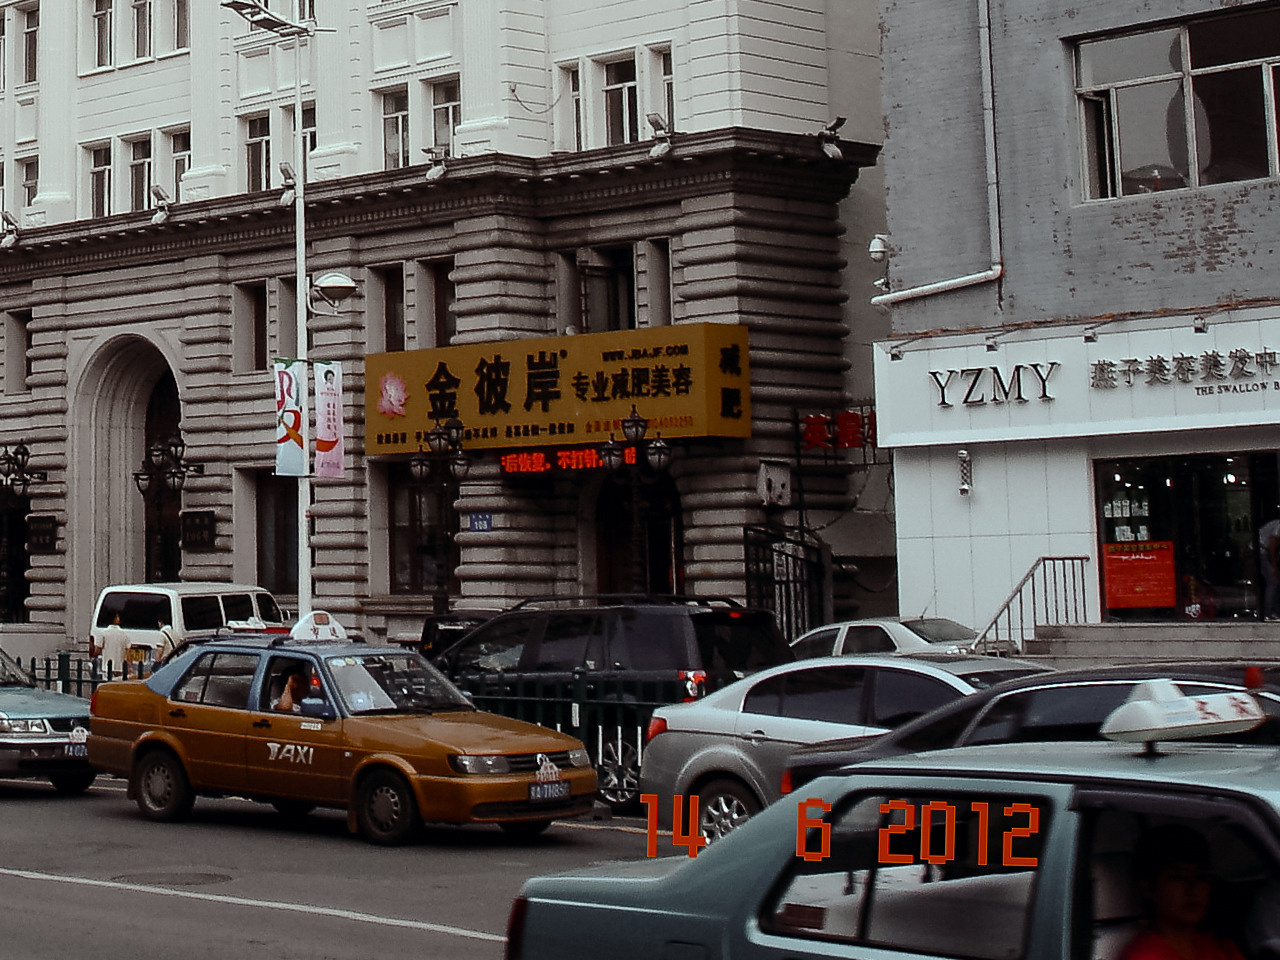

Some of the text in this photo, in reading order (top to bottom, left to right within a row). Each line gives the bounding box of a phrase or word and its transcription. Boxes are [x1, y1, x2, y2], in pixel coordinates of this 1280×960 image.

[425, 351, 561, 420] 金彼岸
[571, 364, 693, 403] 专业减肥美容
[928, 361, 1061, 407] YZMY
[1195, 386, 1214, 396] THE
[1217, 382, 1268, 394] SWALLOW
[266, 742, 314, 764] TAXI
